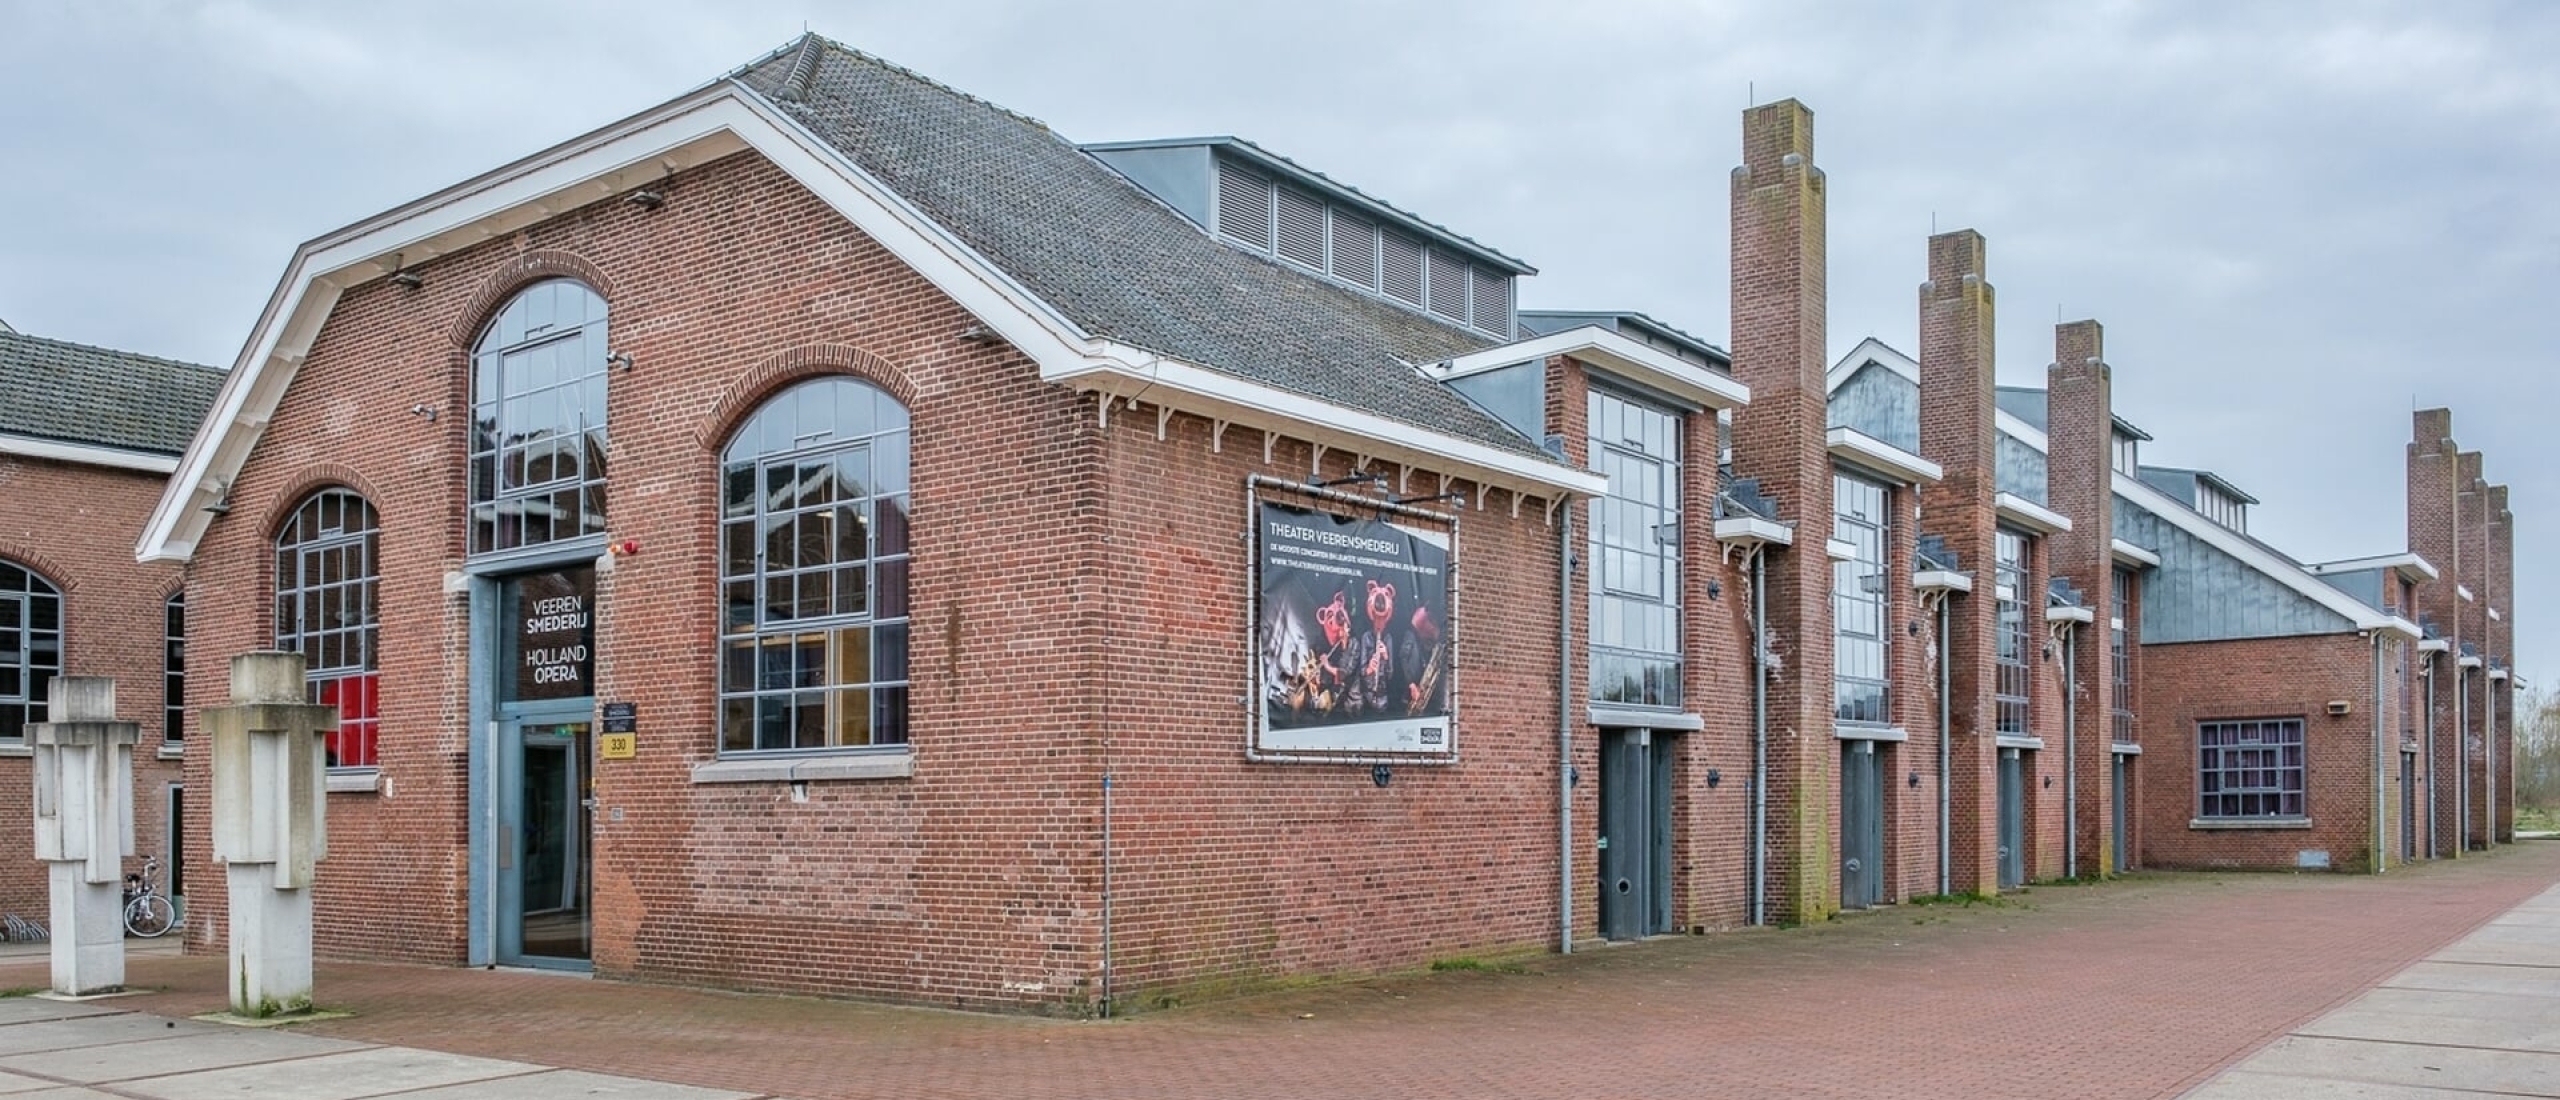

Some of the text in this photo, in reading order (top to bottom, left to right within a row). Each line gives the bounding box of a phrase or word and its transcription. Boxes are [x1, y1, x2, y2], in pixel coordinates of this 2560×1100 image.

[1270, 522, 1399, 555] THEATER VEERENSMEDERIJ
[532, 595, 582, 616] VEEREN
[527, 612, 588, 634] SMEDERIJ
[526, 645, 587, 666] HOLLAND
[535, 664, 579, 684] OPERA
[611, 738, 626, 751] 330
